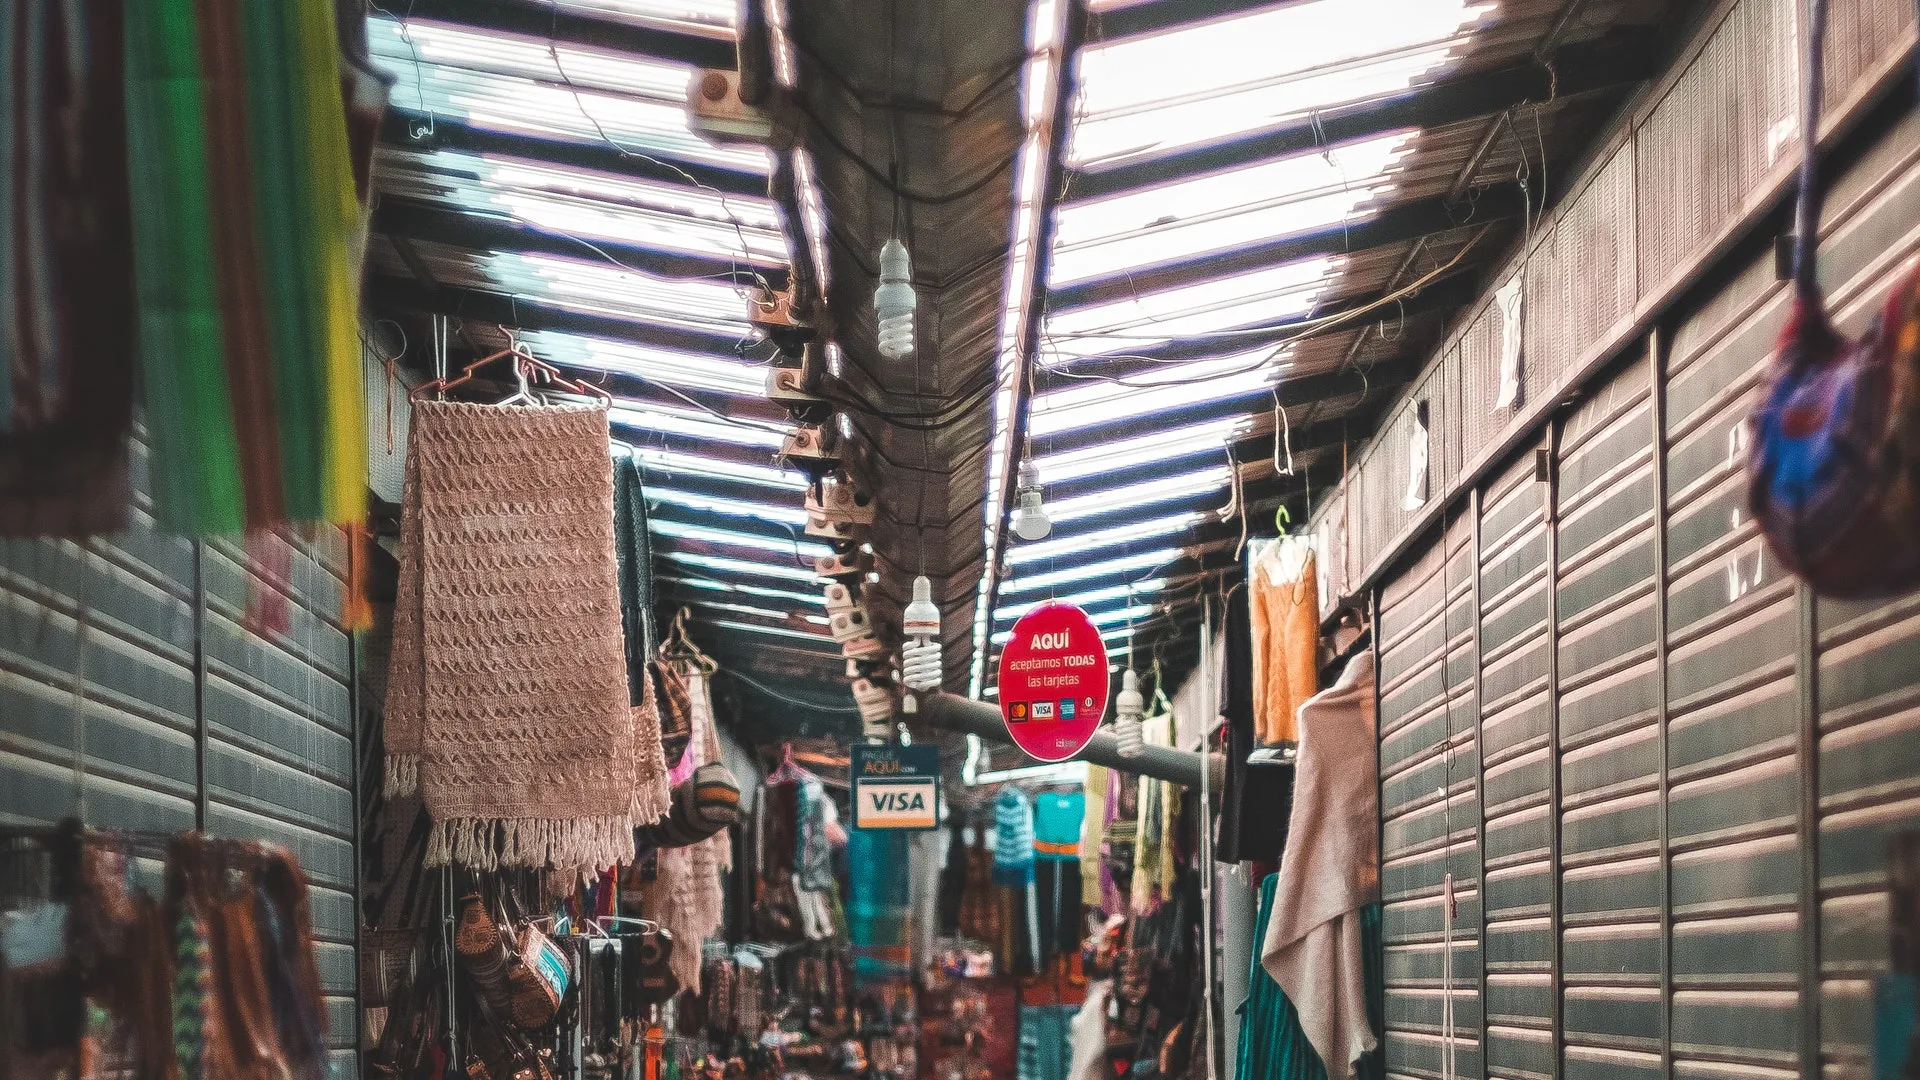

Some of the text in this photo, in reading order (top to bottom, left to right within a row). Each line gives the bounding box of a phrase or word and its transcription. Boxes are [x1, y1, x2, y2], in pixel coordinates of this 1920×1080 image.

[1030, 628, 1070, 650] AQUÍ
[1010, 655, 1095, 672] aceptamos TODAS
[1027, 674, 1079, 688] las tarjetas
[1035, 705, 1052, 714] VISA
[870, 792, 925, 811] VISA
